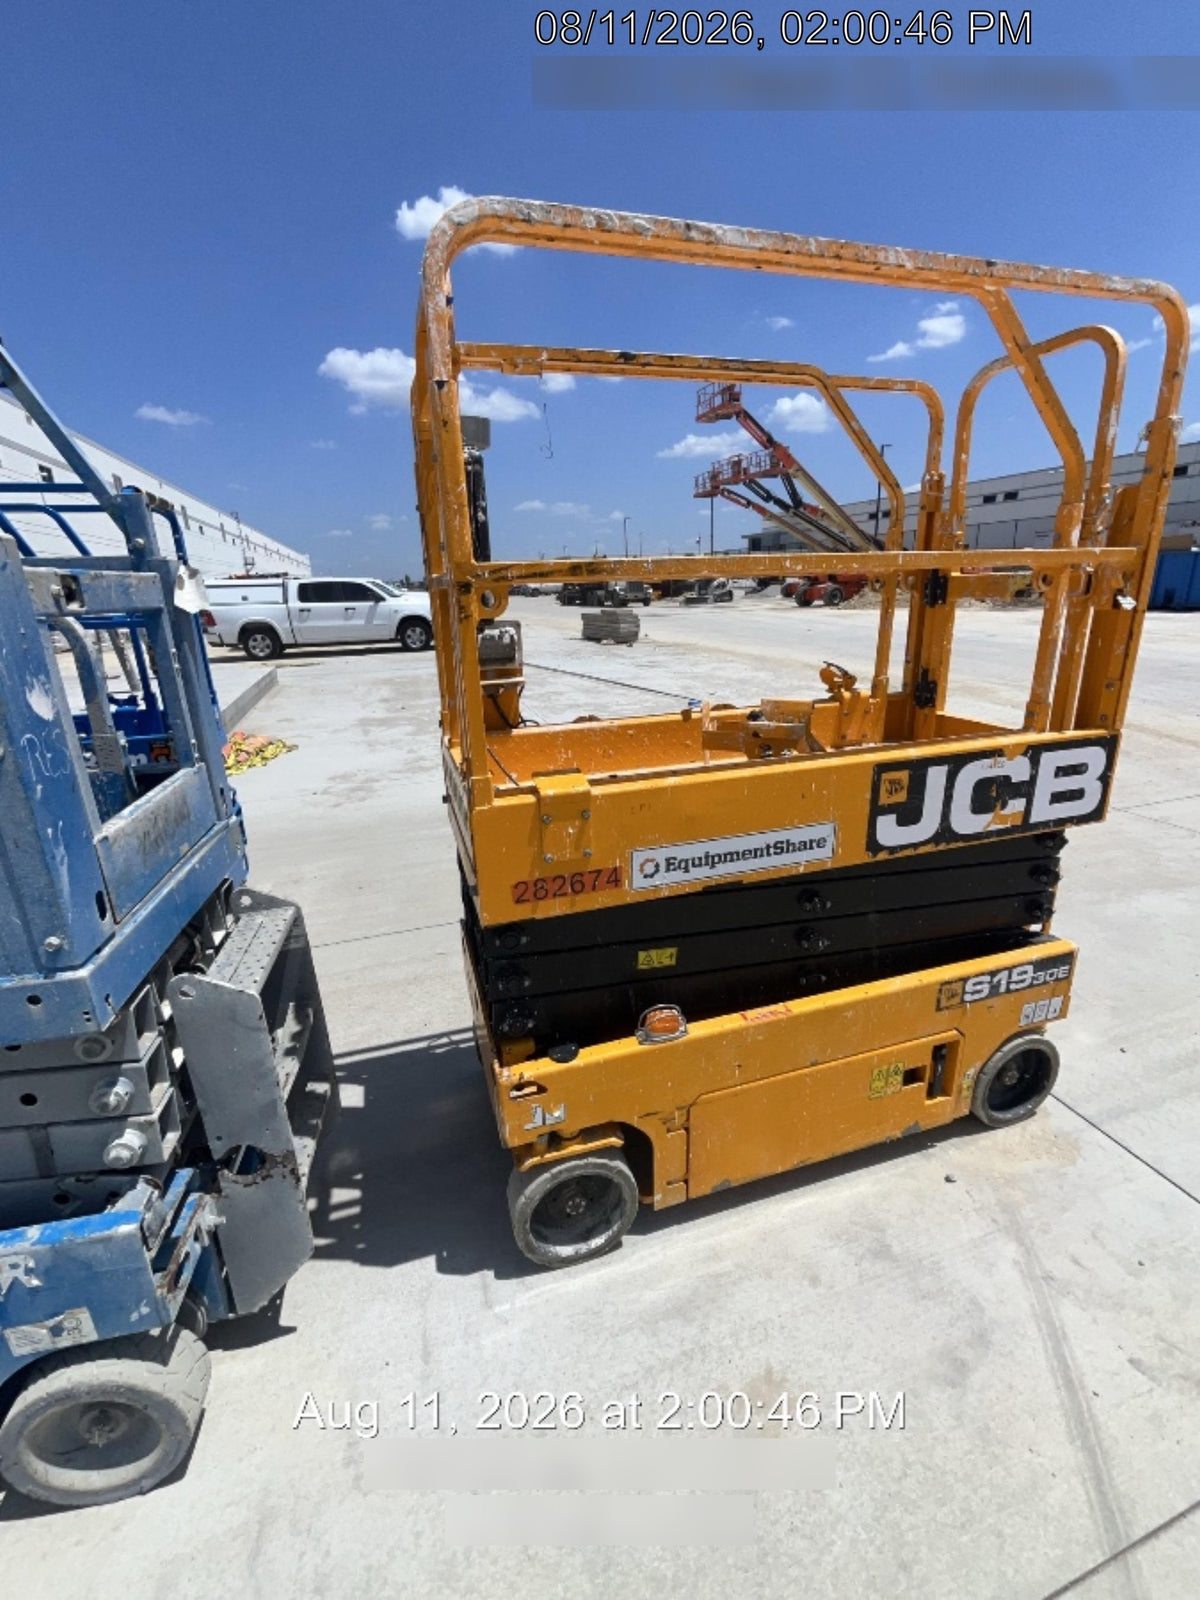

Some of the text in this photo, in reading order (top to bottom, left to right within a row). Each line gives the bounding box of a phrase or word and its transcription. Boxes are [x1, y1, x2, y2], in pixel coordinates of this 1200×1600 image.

[876, 746, 1107, 847] JCB
[664, 835, 829, 873] EquipmentShare
[513, 868, 622, 904] 282674
